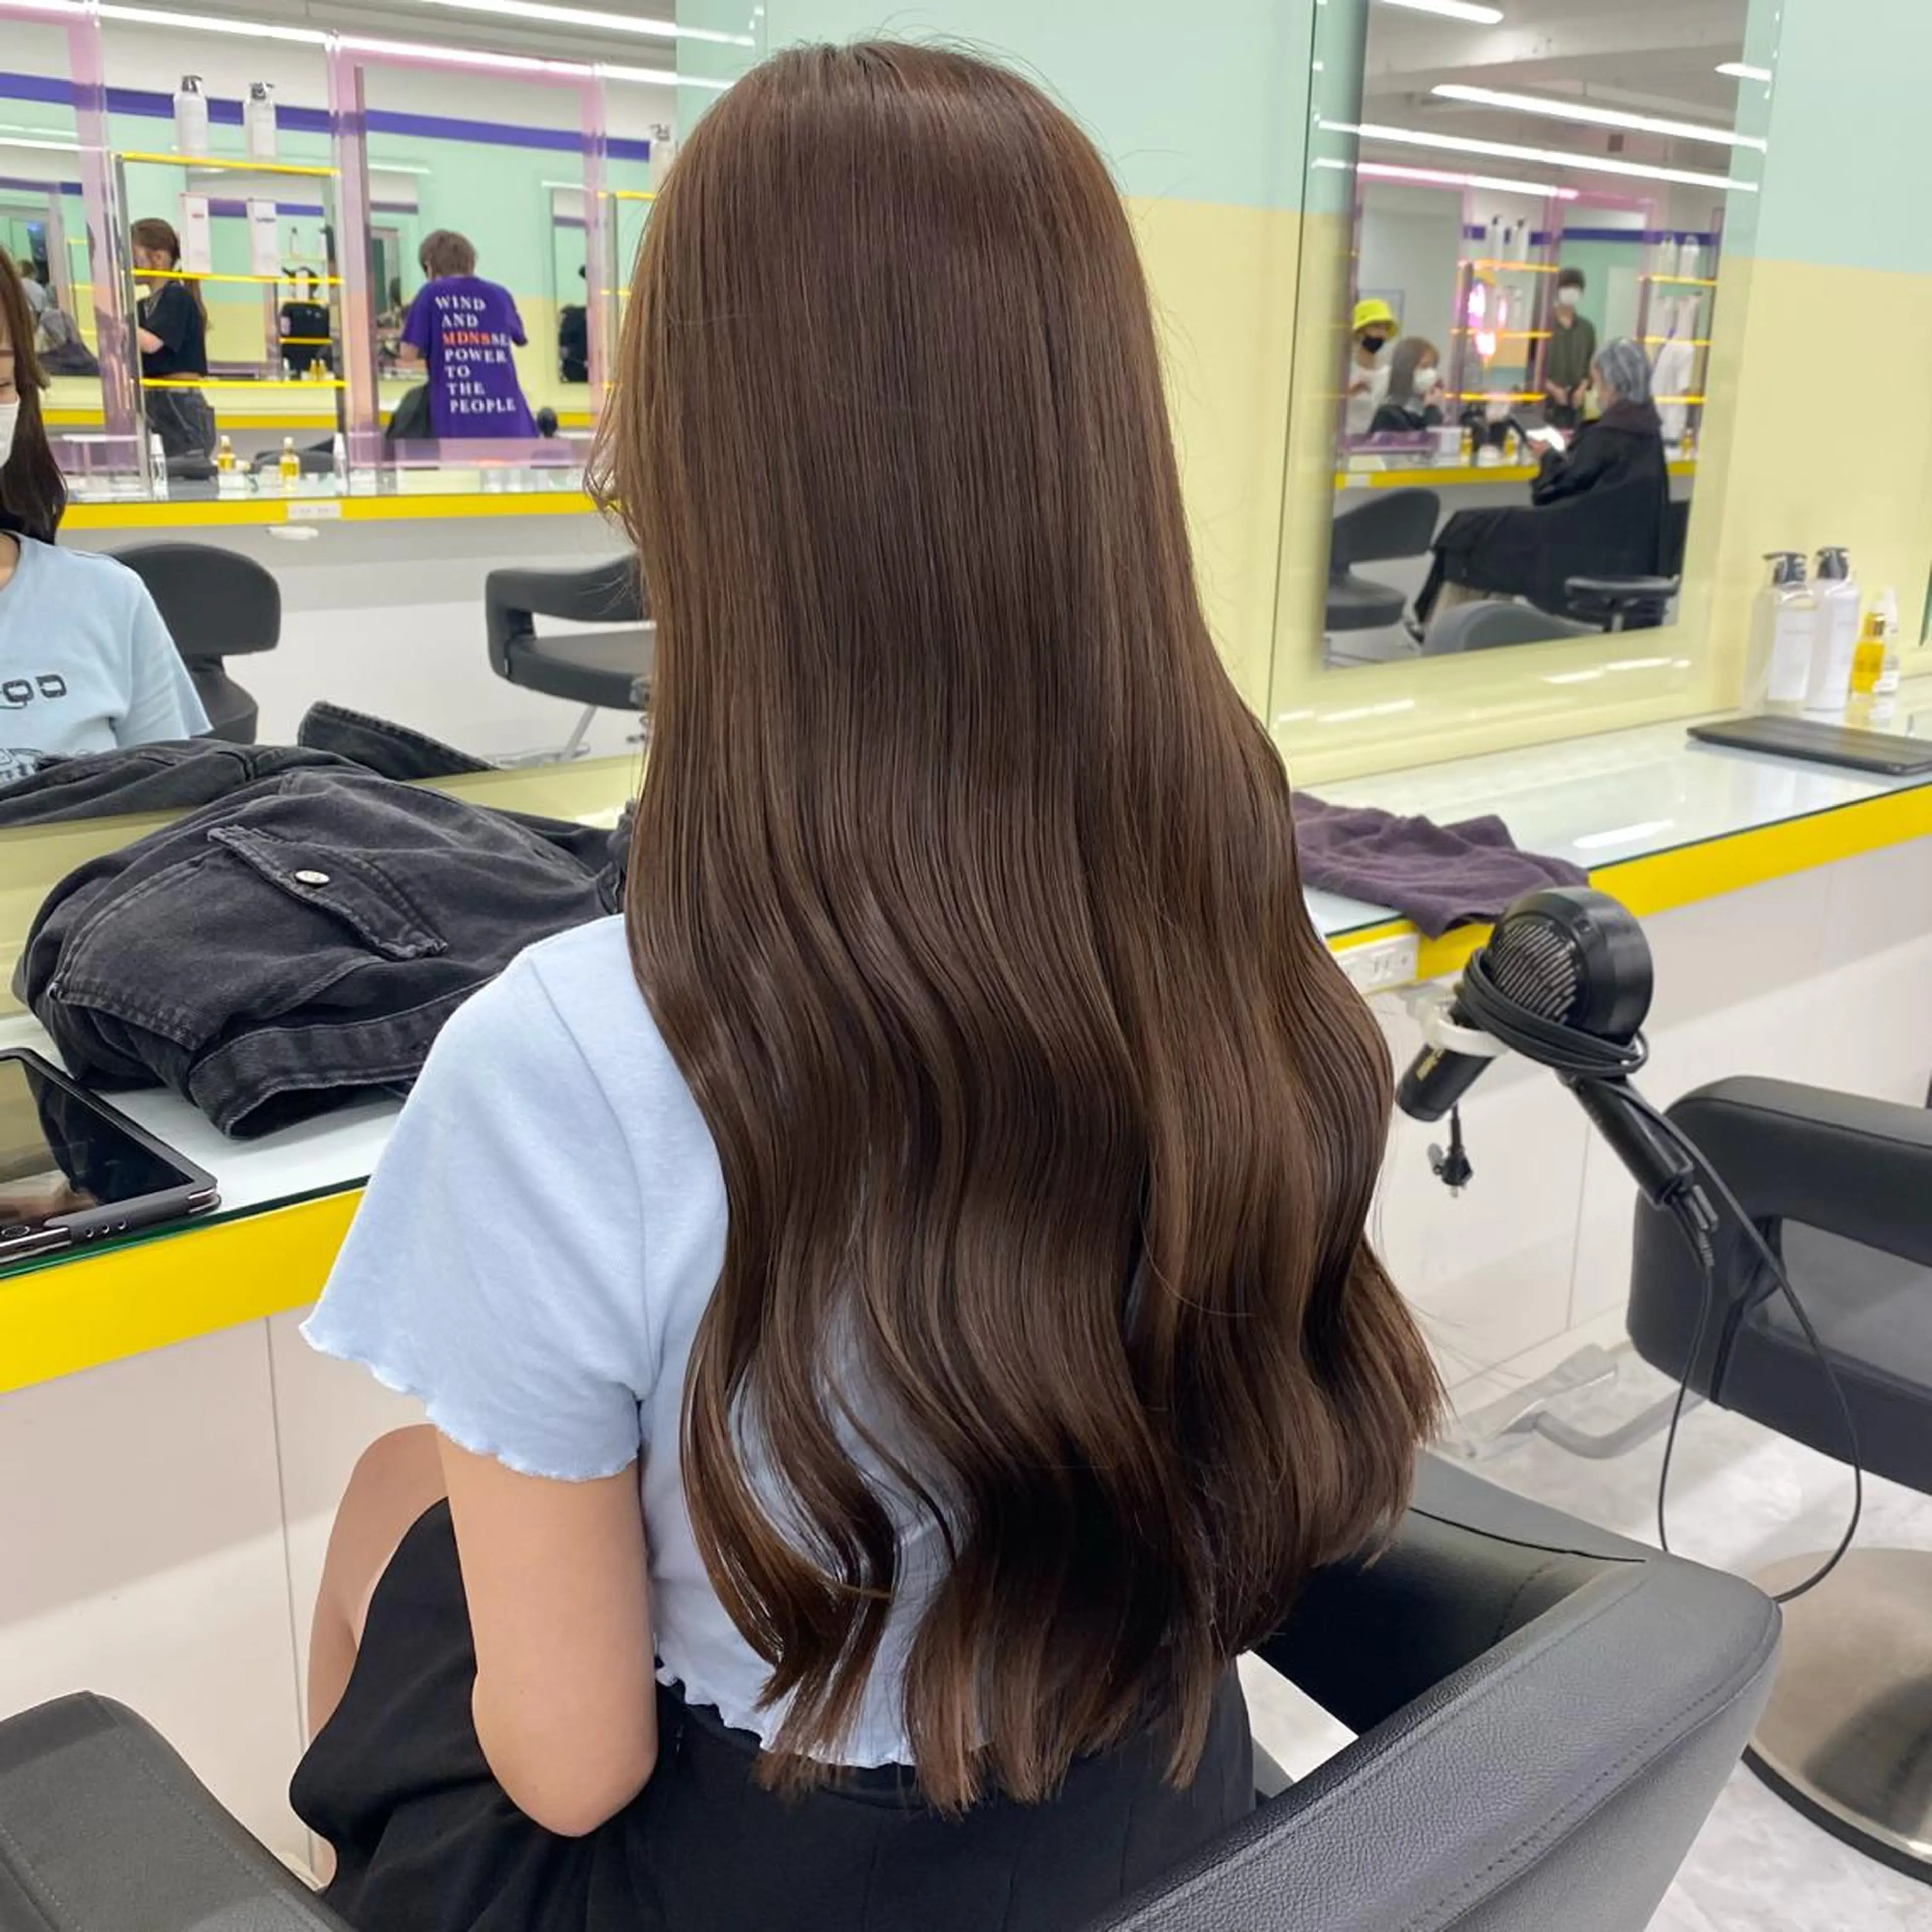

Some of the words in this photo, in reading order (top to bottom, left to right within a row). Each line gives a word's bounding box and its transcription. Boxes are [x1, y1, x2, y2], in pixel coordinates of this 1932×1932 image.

[435, 295, 486, 310] WIND
[442, 313, 478, 327] AND
[445, 348, 506, 363] POWER
[445, 365, 471, 379] TO
[446, 381, 485, 396] THE
[450, 398, 516, 414] PEOPLE
